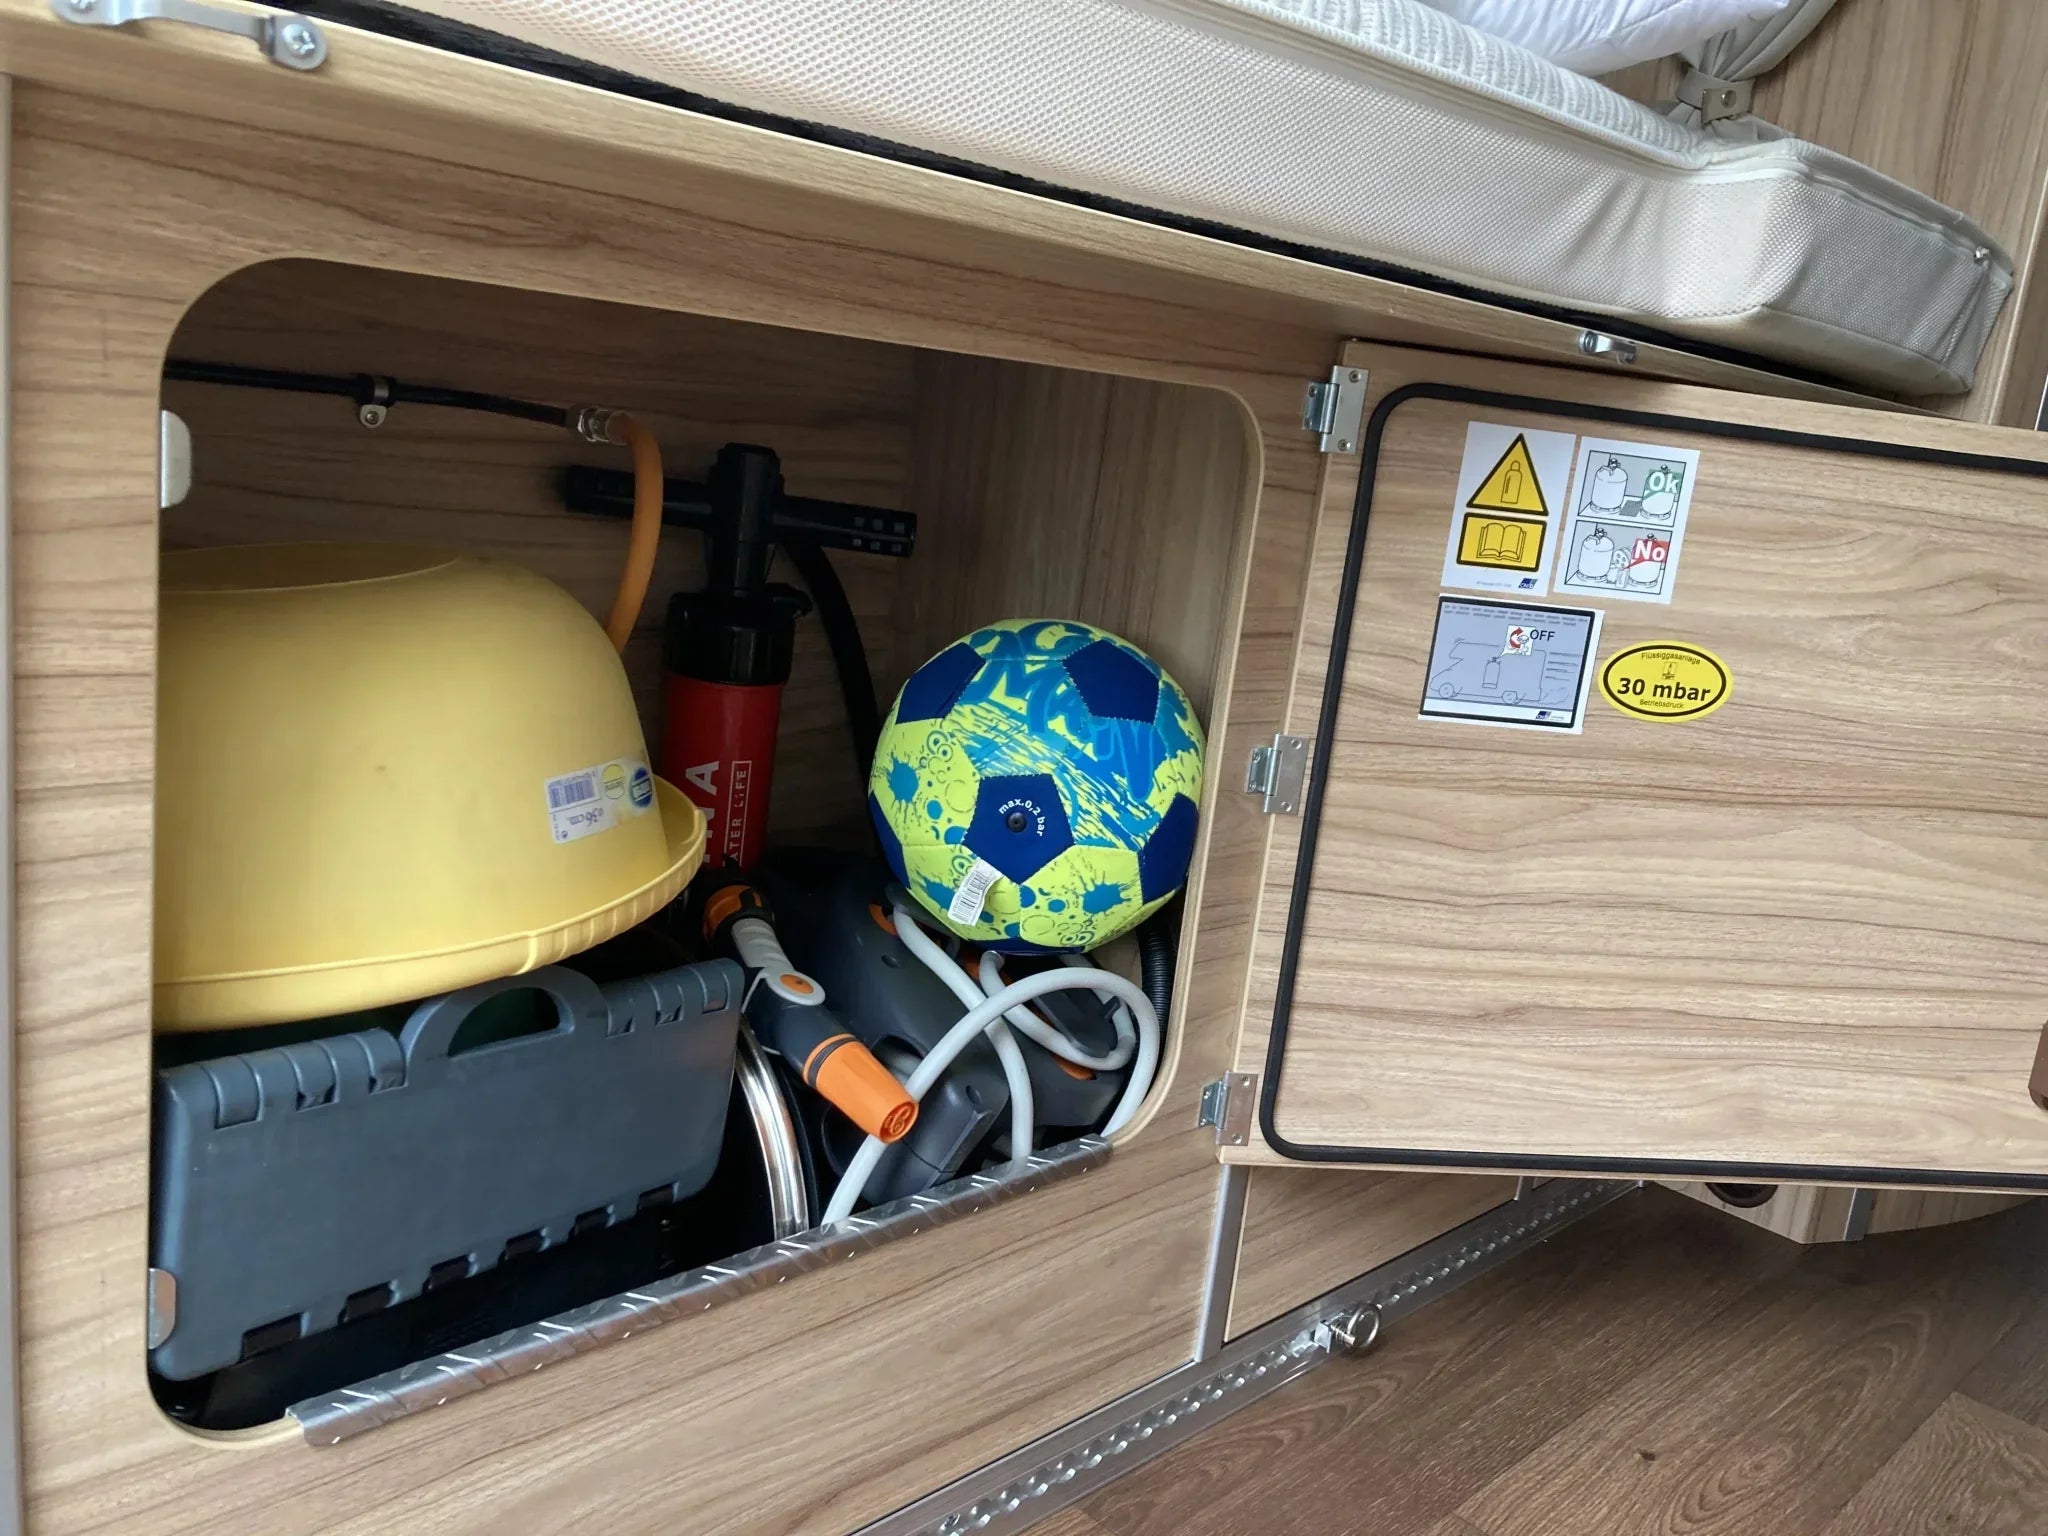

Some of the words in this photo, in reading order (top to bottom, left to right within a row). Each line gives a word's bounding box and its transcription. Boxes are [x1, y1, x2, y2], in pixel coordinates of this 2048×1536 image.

[1649, 471, 1680, 493] Ok
[1634, 540, 1666, 561] No
[1529, 629, 1556, 642] OFF
[1641, 652, 1701, 665] Flüssiggasanlage
[1617, 677, 1646, 696] 30
[1652, 682, 1711, 702] mbar
[1640, 699, 1684, 709] Betriebsdruck
[1036, 816, 1046, 837] bar
[729, 818, 742, 861] ATER
